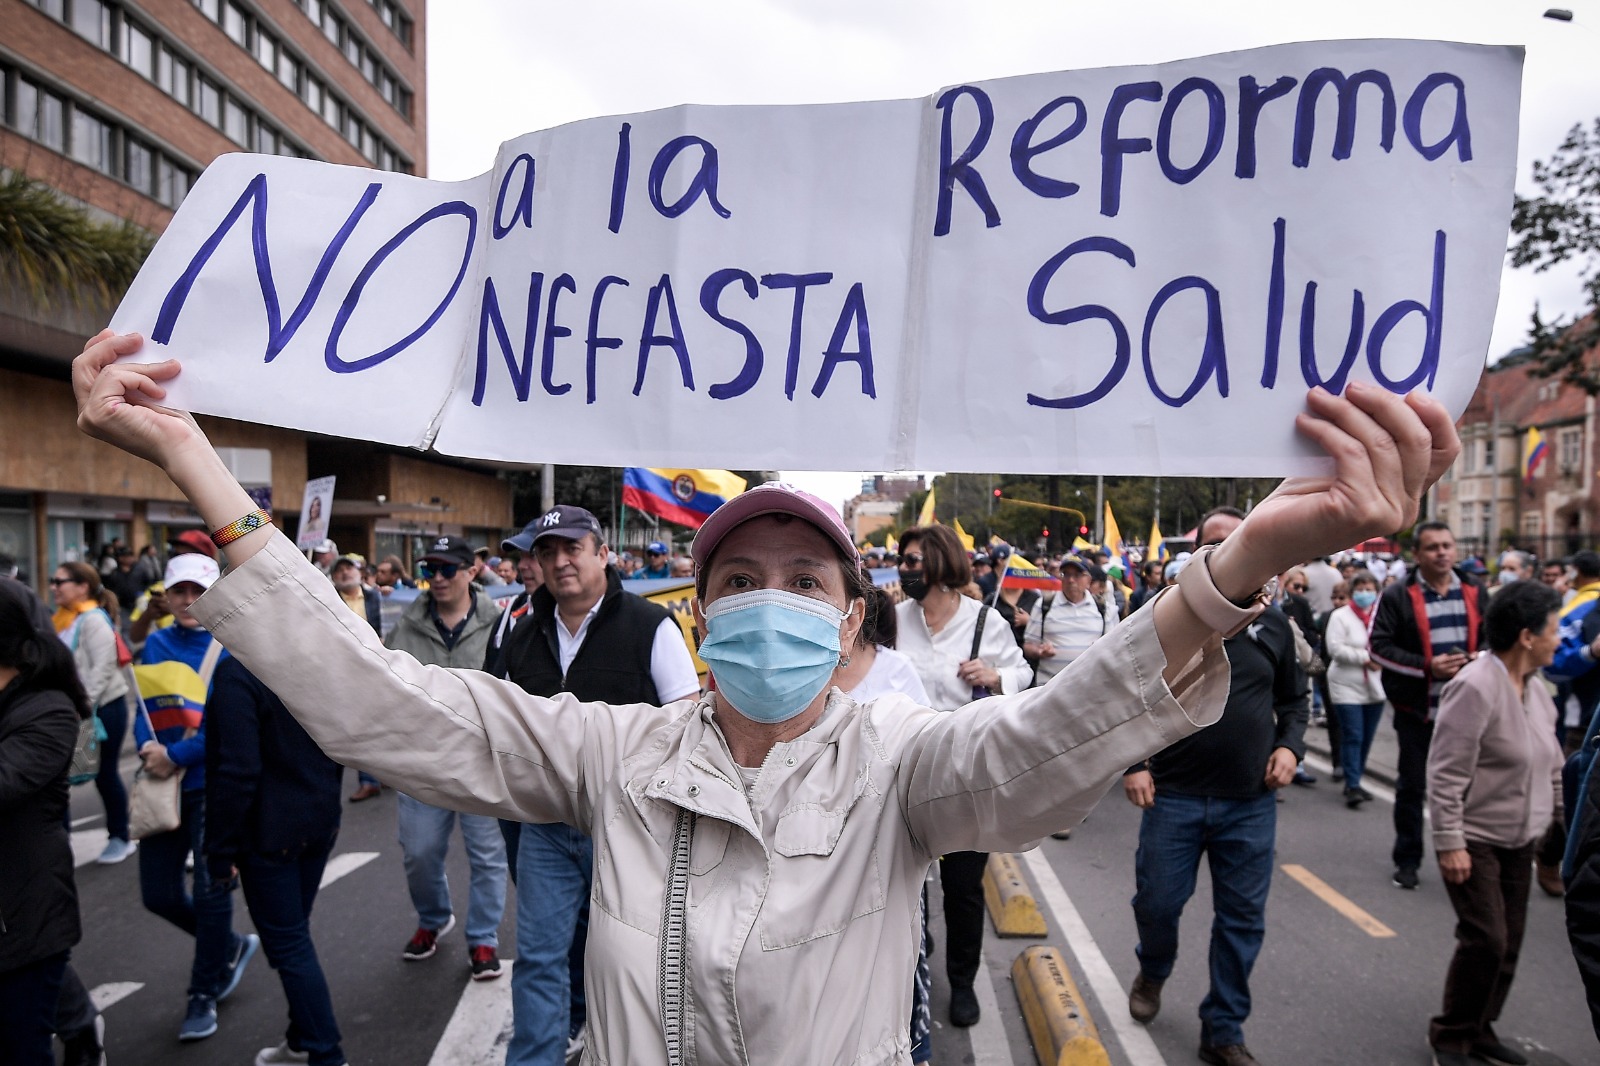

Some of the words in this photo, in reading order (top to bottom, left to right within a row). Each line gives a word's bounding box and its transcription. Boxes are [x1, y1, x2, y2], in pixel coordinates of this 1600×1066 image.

[150, 172, 478, 374] NO
[492, 152, 536, 241] a
[607, 123, 732, 235] la
[471, 267, 877, 407] NEFASTA
[1026, 216, 1447, 410] Salud
[543, 511, 561, 526] NY
